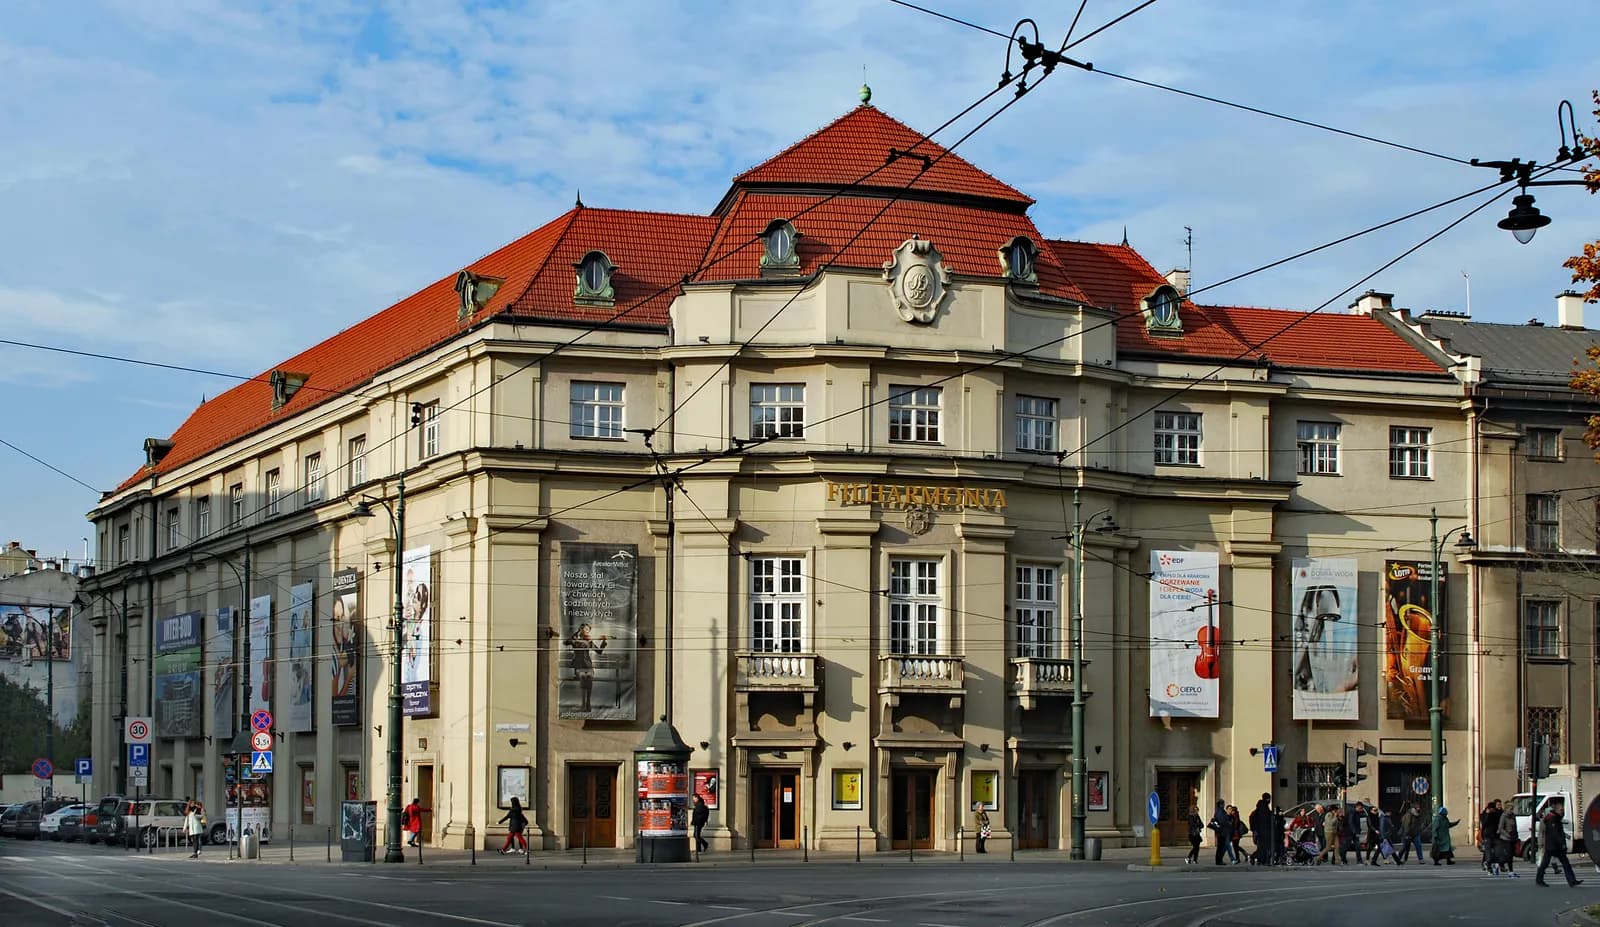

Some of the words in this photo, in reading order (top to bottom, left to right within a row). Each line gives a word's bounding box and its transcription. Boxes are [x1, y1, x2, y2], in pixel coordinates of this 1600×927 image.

[827, 482, 1008, 508] FILHARMONIA
[564, 571, 588, 579] Nasza
[132, 726, 144, 734] 30
[134, 746, 144, 760] P
[79, 760, 89, 774] P
